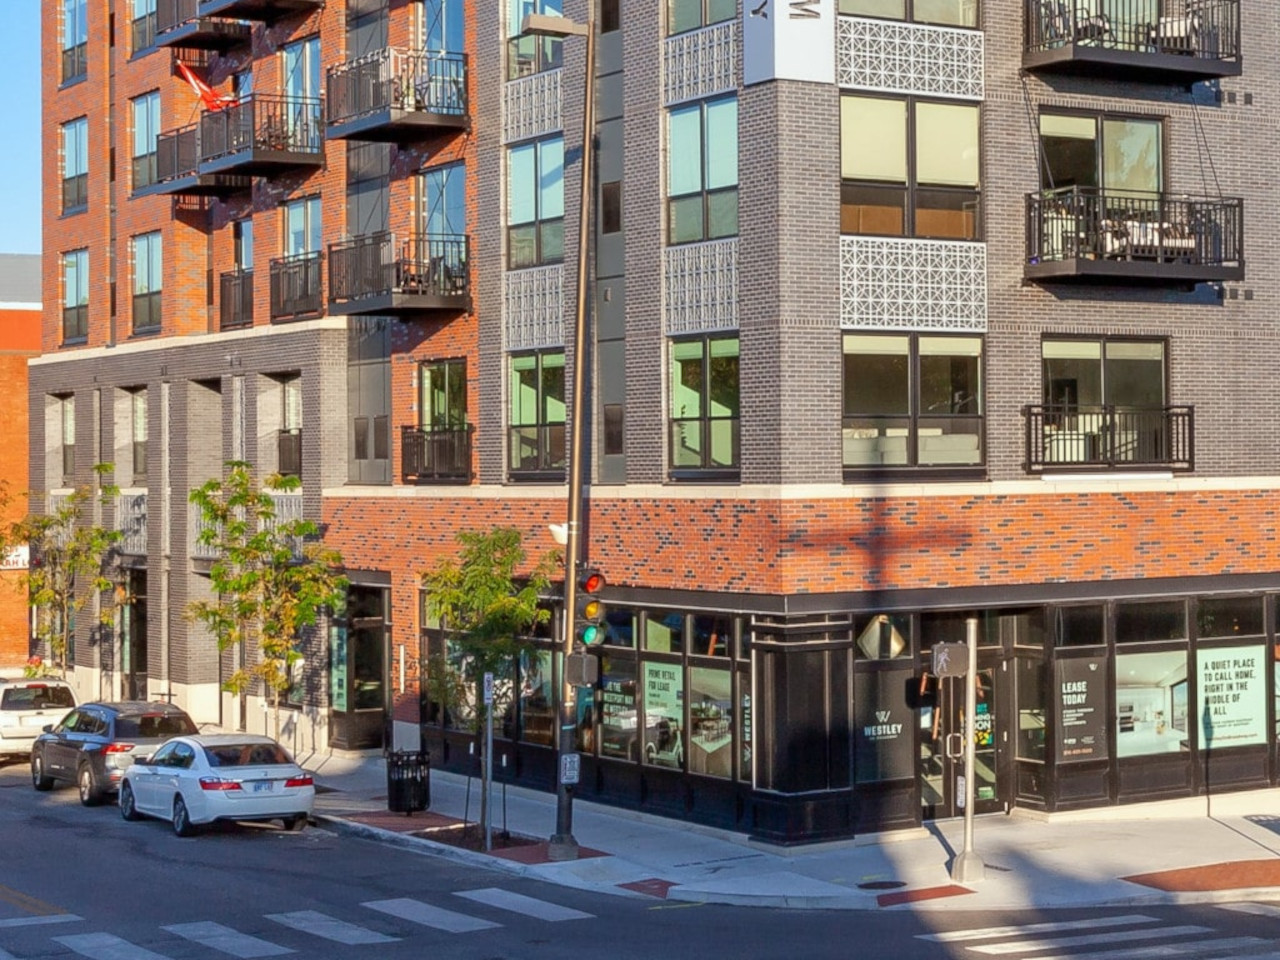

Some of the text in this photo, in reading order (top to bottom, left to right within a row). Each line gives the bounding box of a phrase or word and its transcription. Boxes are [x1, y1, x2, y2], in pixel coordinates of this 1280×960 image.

[1204, 658, 1255, 671] A QUIET PLACE
[648, 669, 676, 681] PRIME RETAIL
[1204, 672, 1213, 682] TO
[1214, 671, 1232, 681] CALL
[648, 681, 670, 692] FOR LEASE
[1062, 681, 1088, 693] LEASE
[1204, 681, 1249, 694] RIGHT IN THE
[1062, 693, 1088, 705] TODAY
[1204, 692, 1241, 705] MIDDLE OF
[1213, 705, 1227, 716] ALL
[864, 723, 903, 737] WESTLEY
